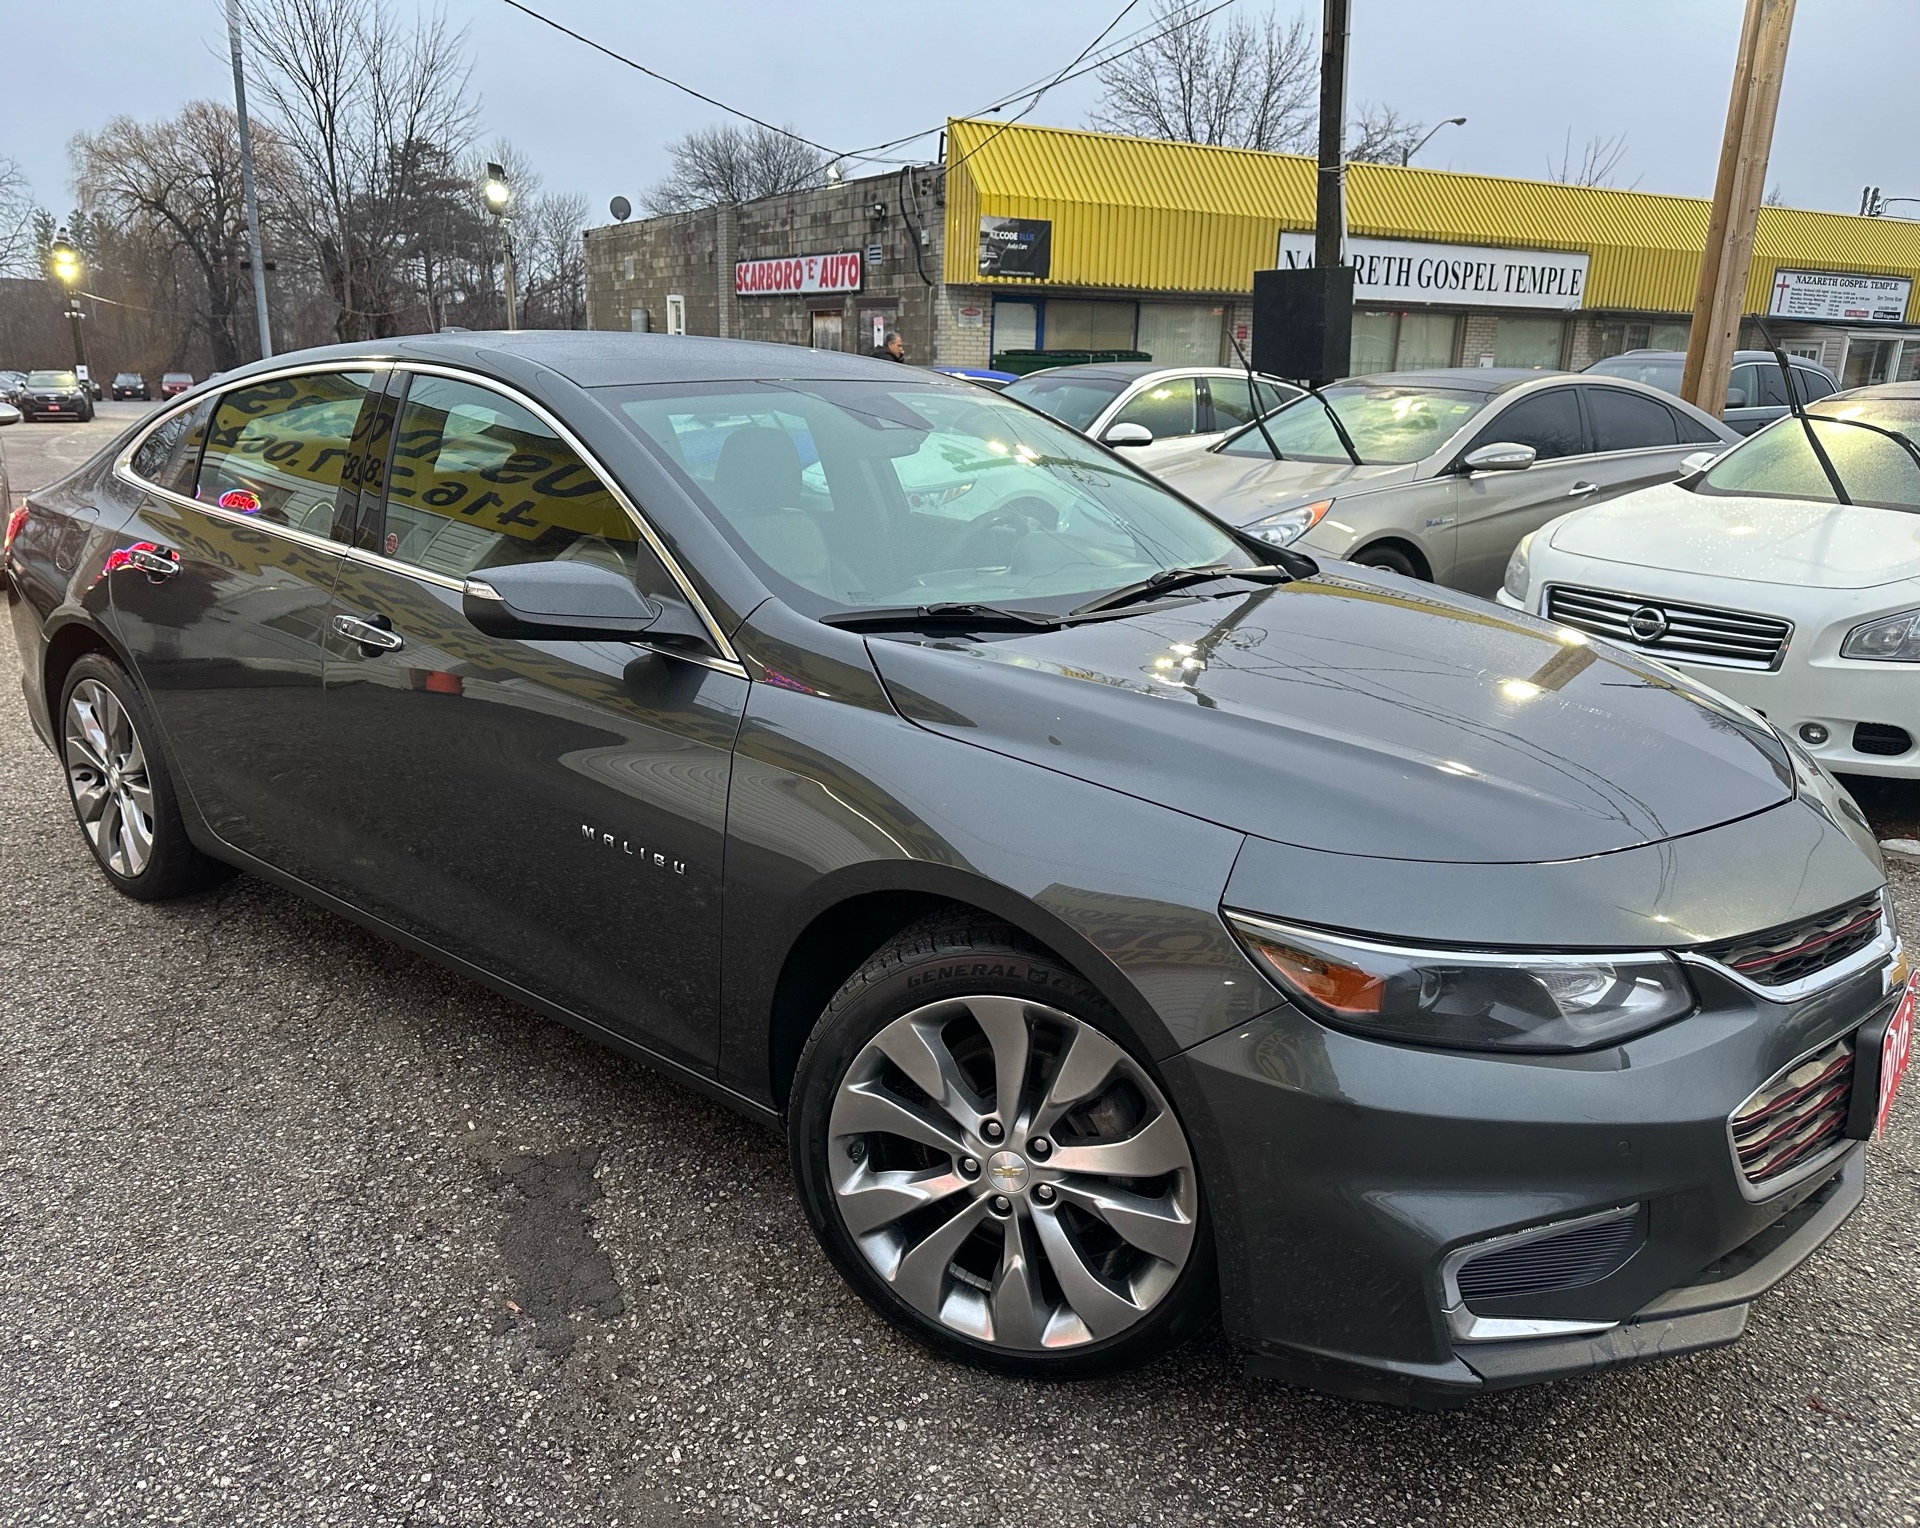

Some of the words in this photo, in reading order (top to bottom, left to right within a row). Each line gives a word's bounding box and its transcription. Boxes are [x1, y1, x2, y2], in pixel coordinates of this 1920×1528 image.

[736, 259, 804, 292] SCARBORO
[819, 254, 859, 289] AUTO
[1285, 250, 1413, 287] NARETH
[1417, 258, 1499, 291] GOSPEL
[1503, 264, 1583, 297] TEMPLE
[1795, 275, 1839, 287] NAZARETH
[1839, 278, 1869, 289] GOSPEL
[1870, 280, 1899, 291] TEMPLE
[581, 824, 686, 876] MALIBU
[907, 963, 1022, 989] GENERAL
